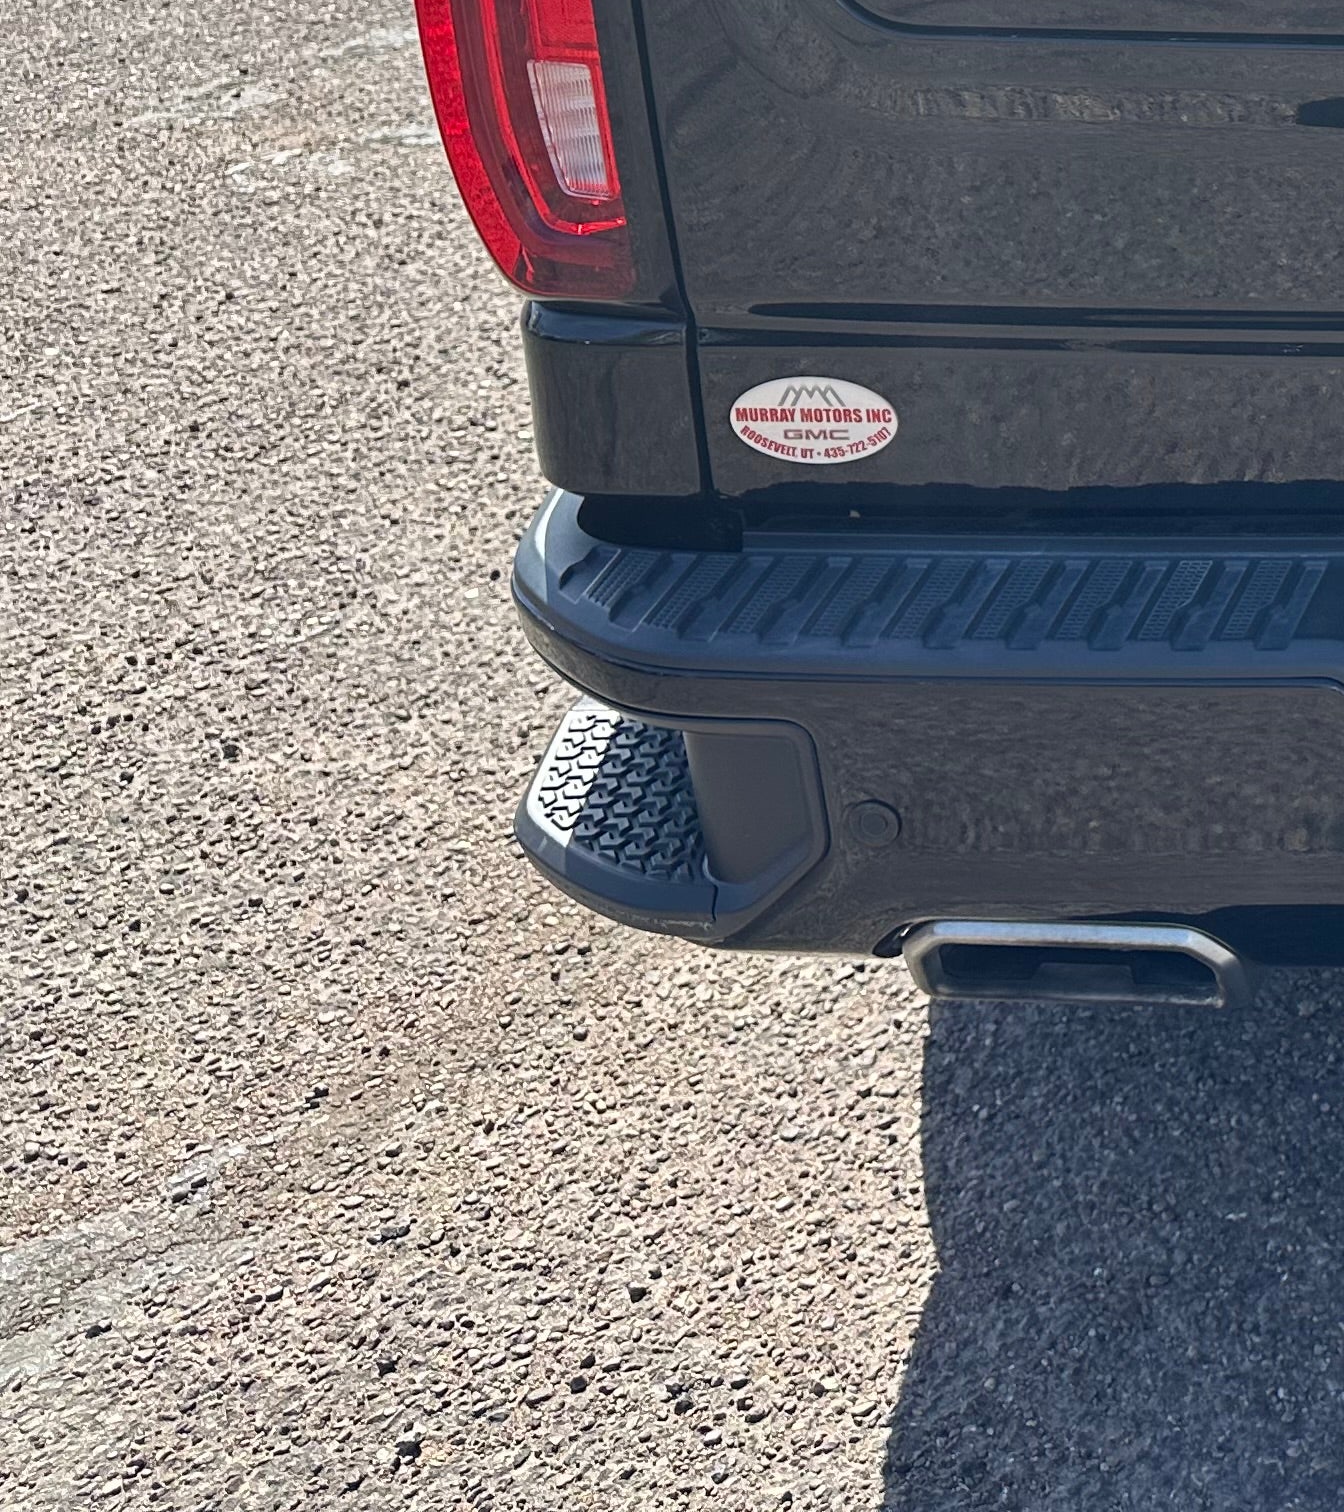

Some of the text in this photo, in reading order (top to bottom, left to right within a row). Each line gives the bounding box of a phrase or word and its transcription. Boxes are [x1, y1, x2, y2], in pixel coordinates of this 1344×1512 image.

[735, 407, 892, 423] MURRAY MOTORS INC
[783, 429, 850, 441] GMC
[800, 448, 815, 459] UT
[823, 426, 892, 459] 435-722-5107
